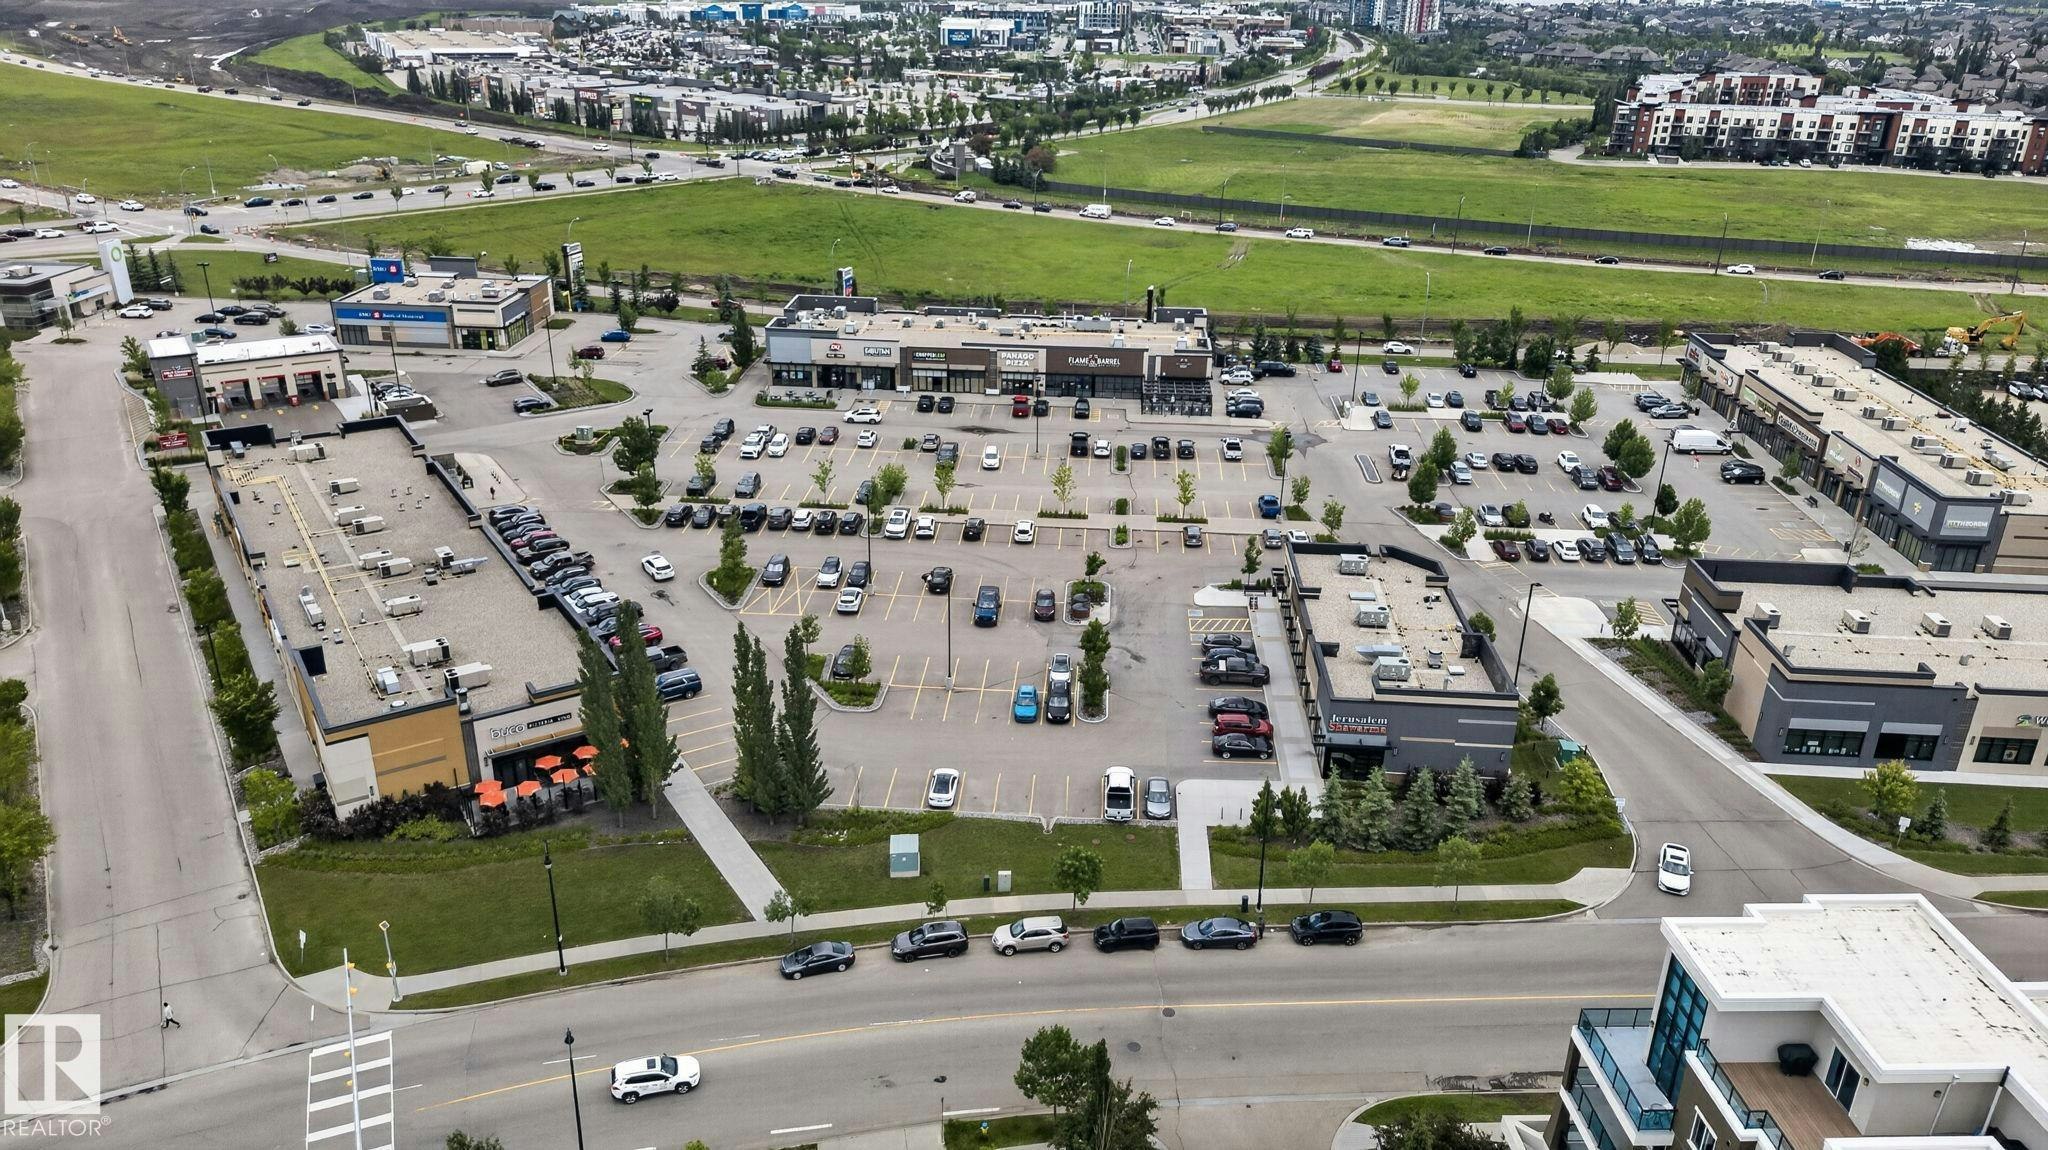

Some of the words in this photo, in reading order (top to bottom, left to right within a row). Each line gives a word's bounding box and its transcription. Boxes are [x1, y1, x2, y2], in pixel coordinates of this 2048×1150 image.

[1001, 352, 1035, 360] PANAGO
[1068, 356, 1089, 364] FLAME
[1097, 357, 1121, 365] BARREL
[1332, 714, 1388, 725] Jerusalem
[490, 723, 526, 739] buco
[1328, 721, 1387, 734] Shawarma
